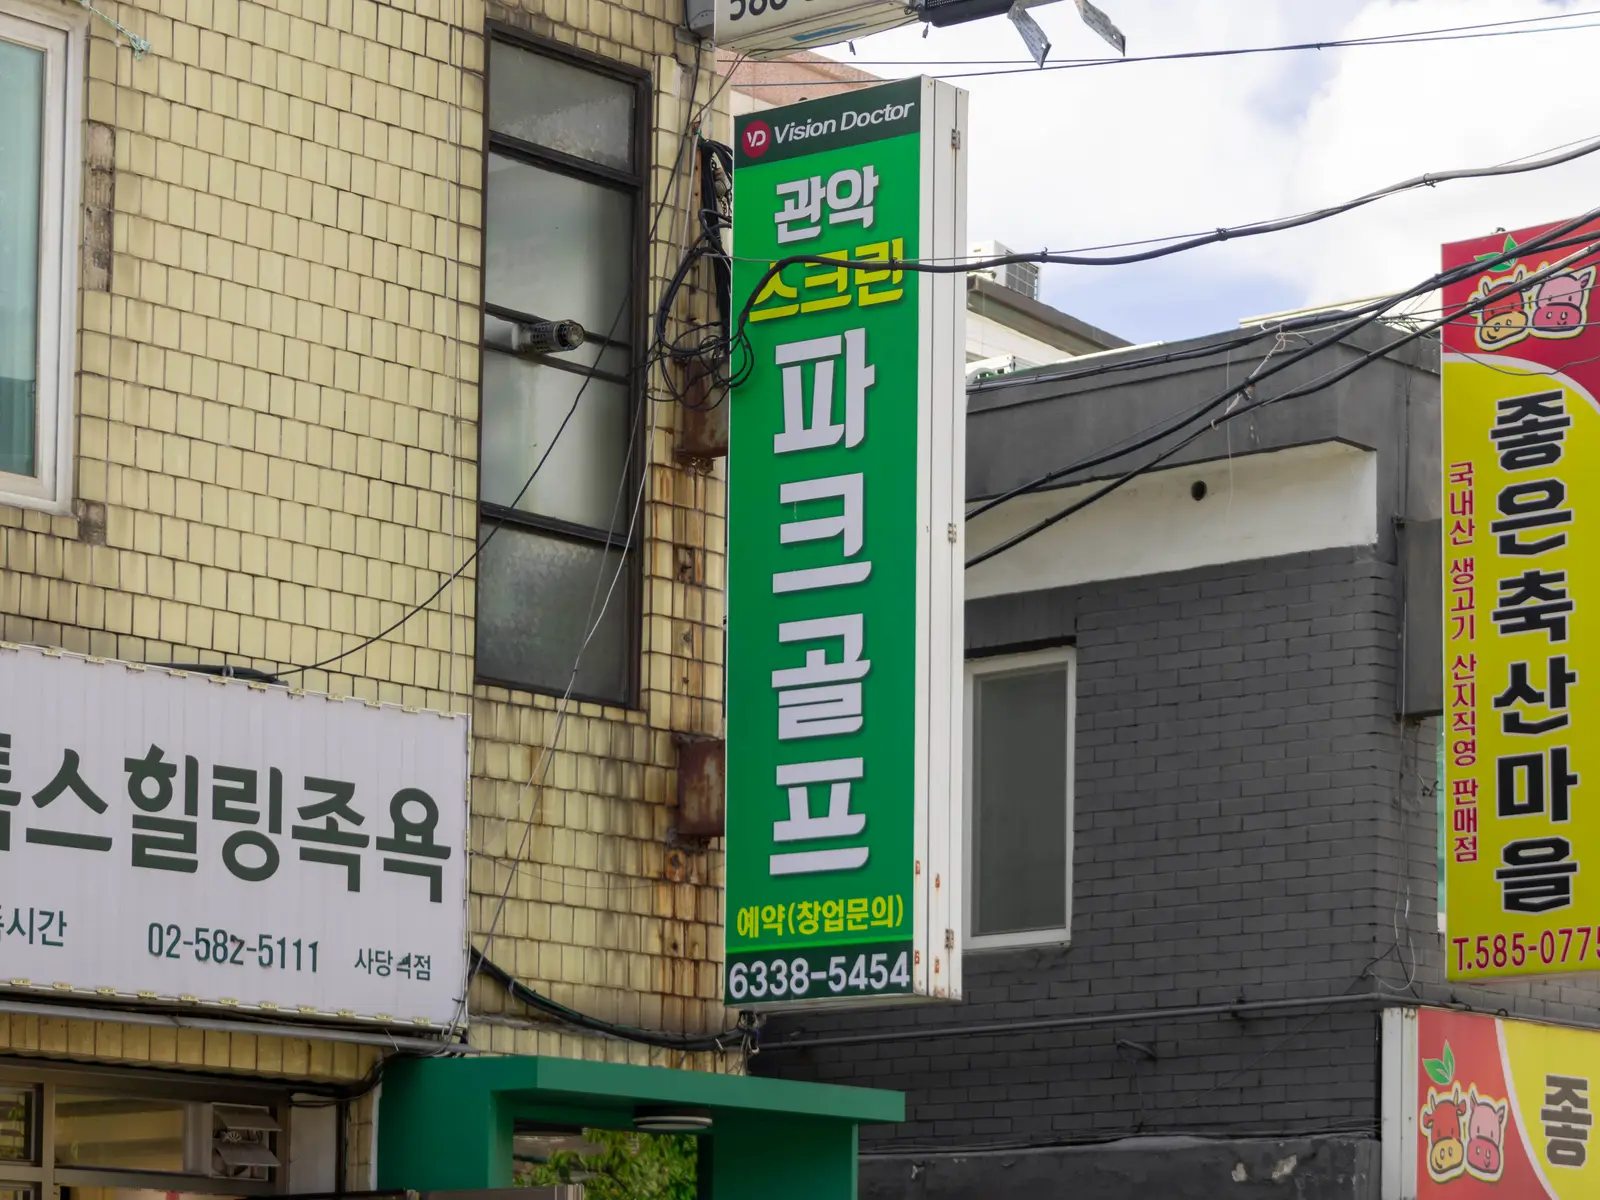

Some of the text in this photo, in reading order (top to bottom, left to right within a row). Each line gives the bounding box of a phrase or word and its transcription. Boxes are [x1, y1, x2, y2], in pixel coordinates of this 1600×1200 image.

[774, 118, 837, 144] Vision
[840, 101, 915, 131] Doctor
[774, 165, 879, 244] 관악
[749, 237, 904, 323] 스크린
[769, 327, 875, 876] 파크골프
[1449, 461, 1479, 863] 국내산 생고기 산지직영 판매점
[1488, 389, 1580, 916] 좋은축산마을
[0, 733, 451, 904] 스힐링족욕
[0, 905, 67, 947] 시간
[148, 922, 319, 973] 02-582-5111
[737, 894, 904, 939] 예약(창업문의)
[1452, 926, 1600, 972] T.585-077
[729, 951, 910, 999] 6338-5454
[1540, 1074, 1593, 1168] 좋
